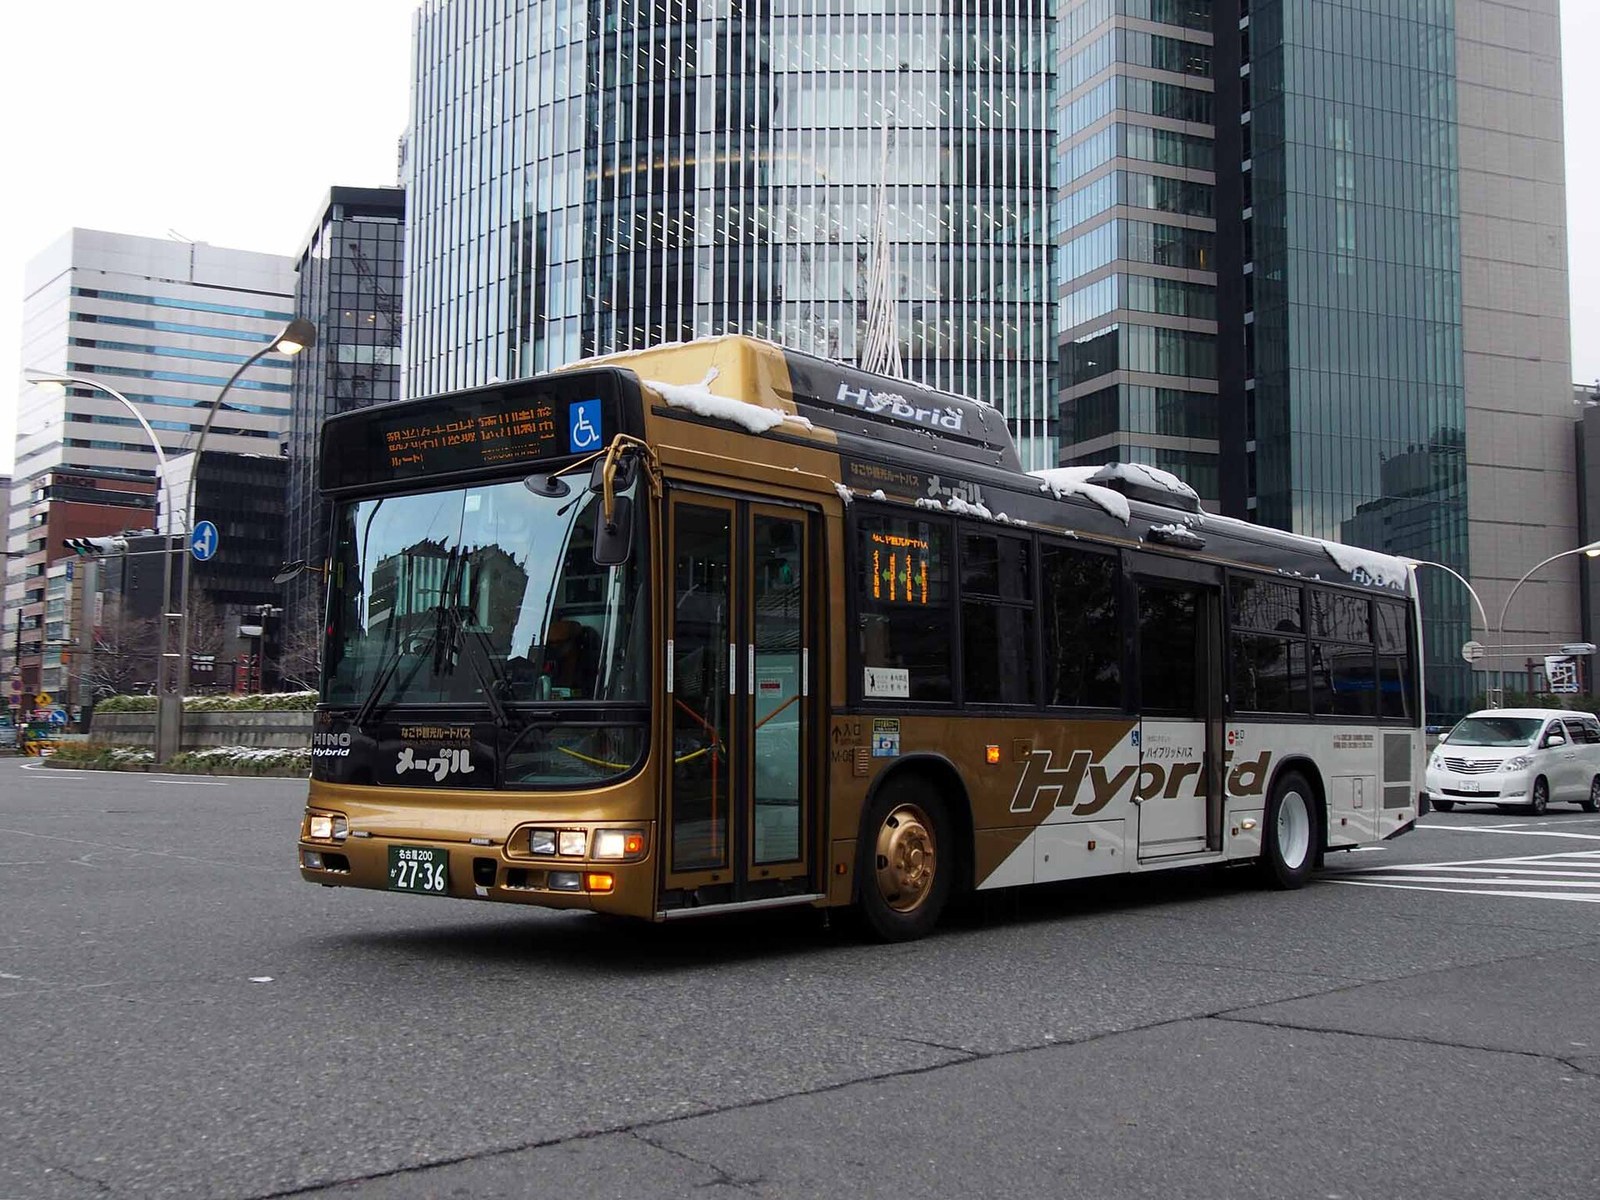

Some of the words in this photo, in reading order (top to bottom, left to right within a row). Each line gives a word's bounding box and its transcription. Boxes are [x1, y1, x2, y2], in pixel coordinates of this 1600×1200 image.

[836, 382, 963, 431] Hybrid
[927, 474, 985, 504] メーグル
[313, 732, 351, 746] HINO
[313, 748, 350, 757] Hybrid
[395, 748, 475, 782] メーグル
